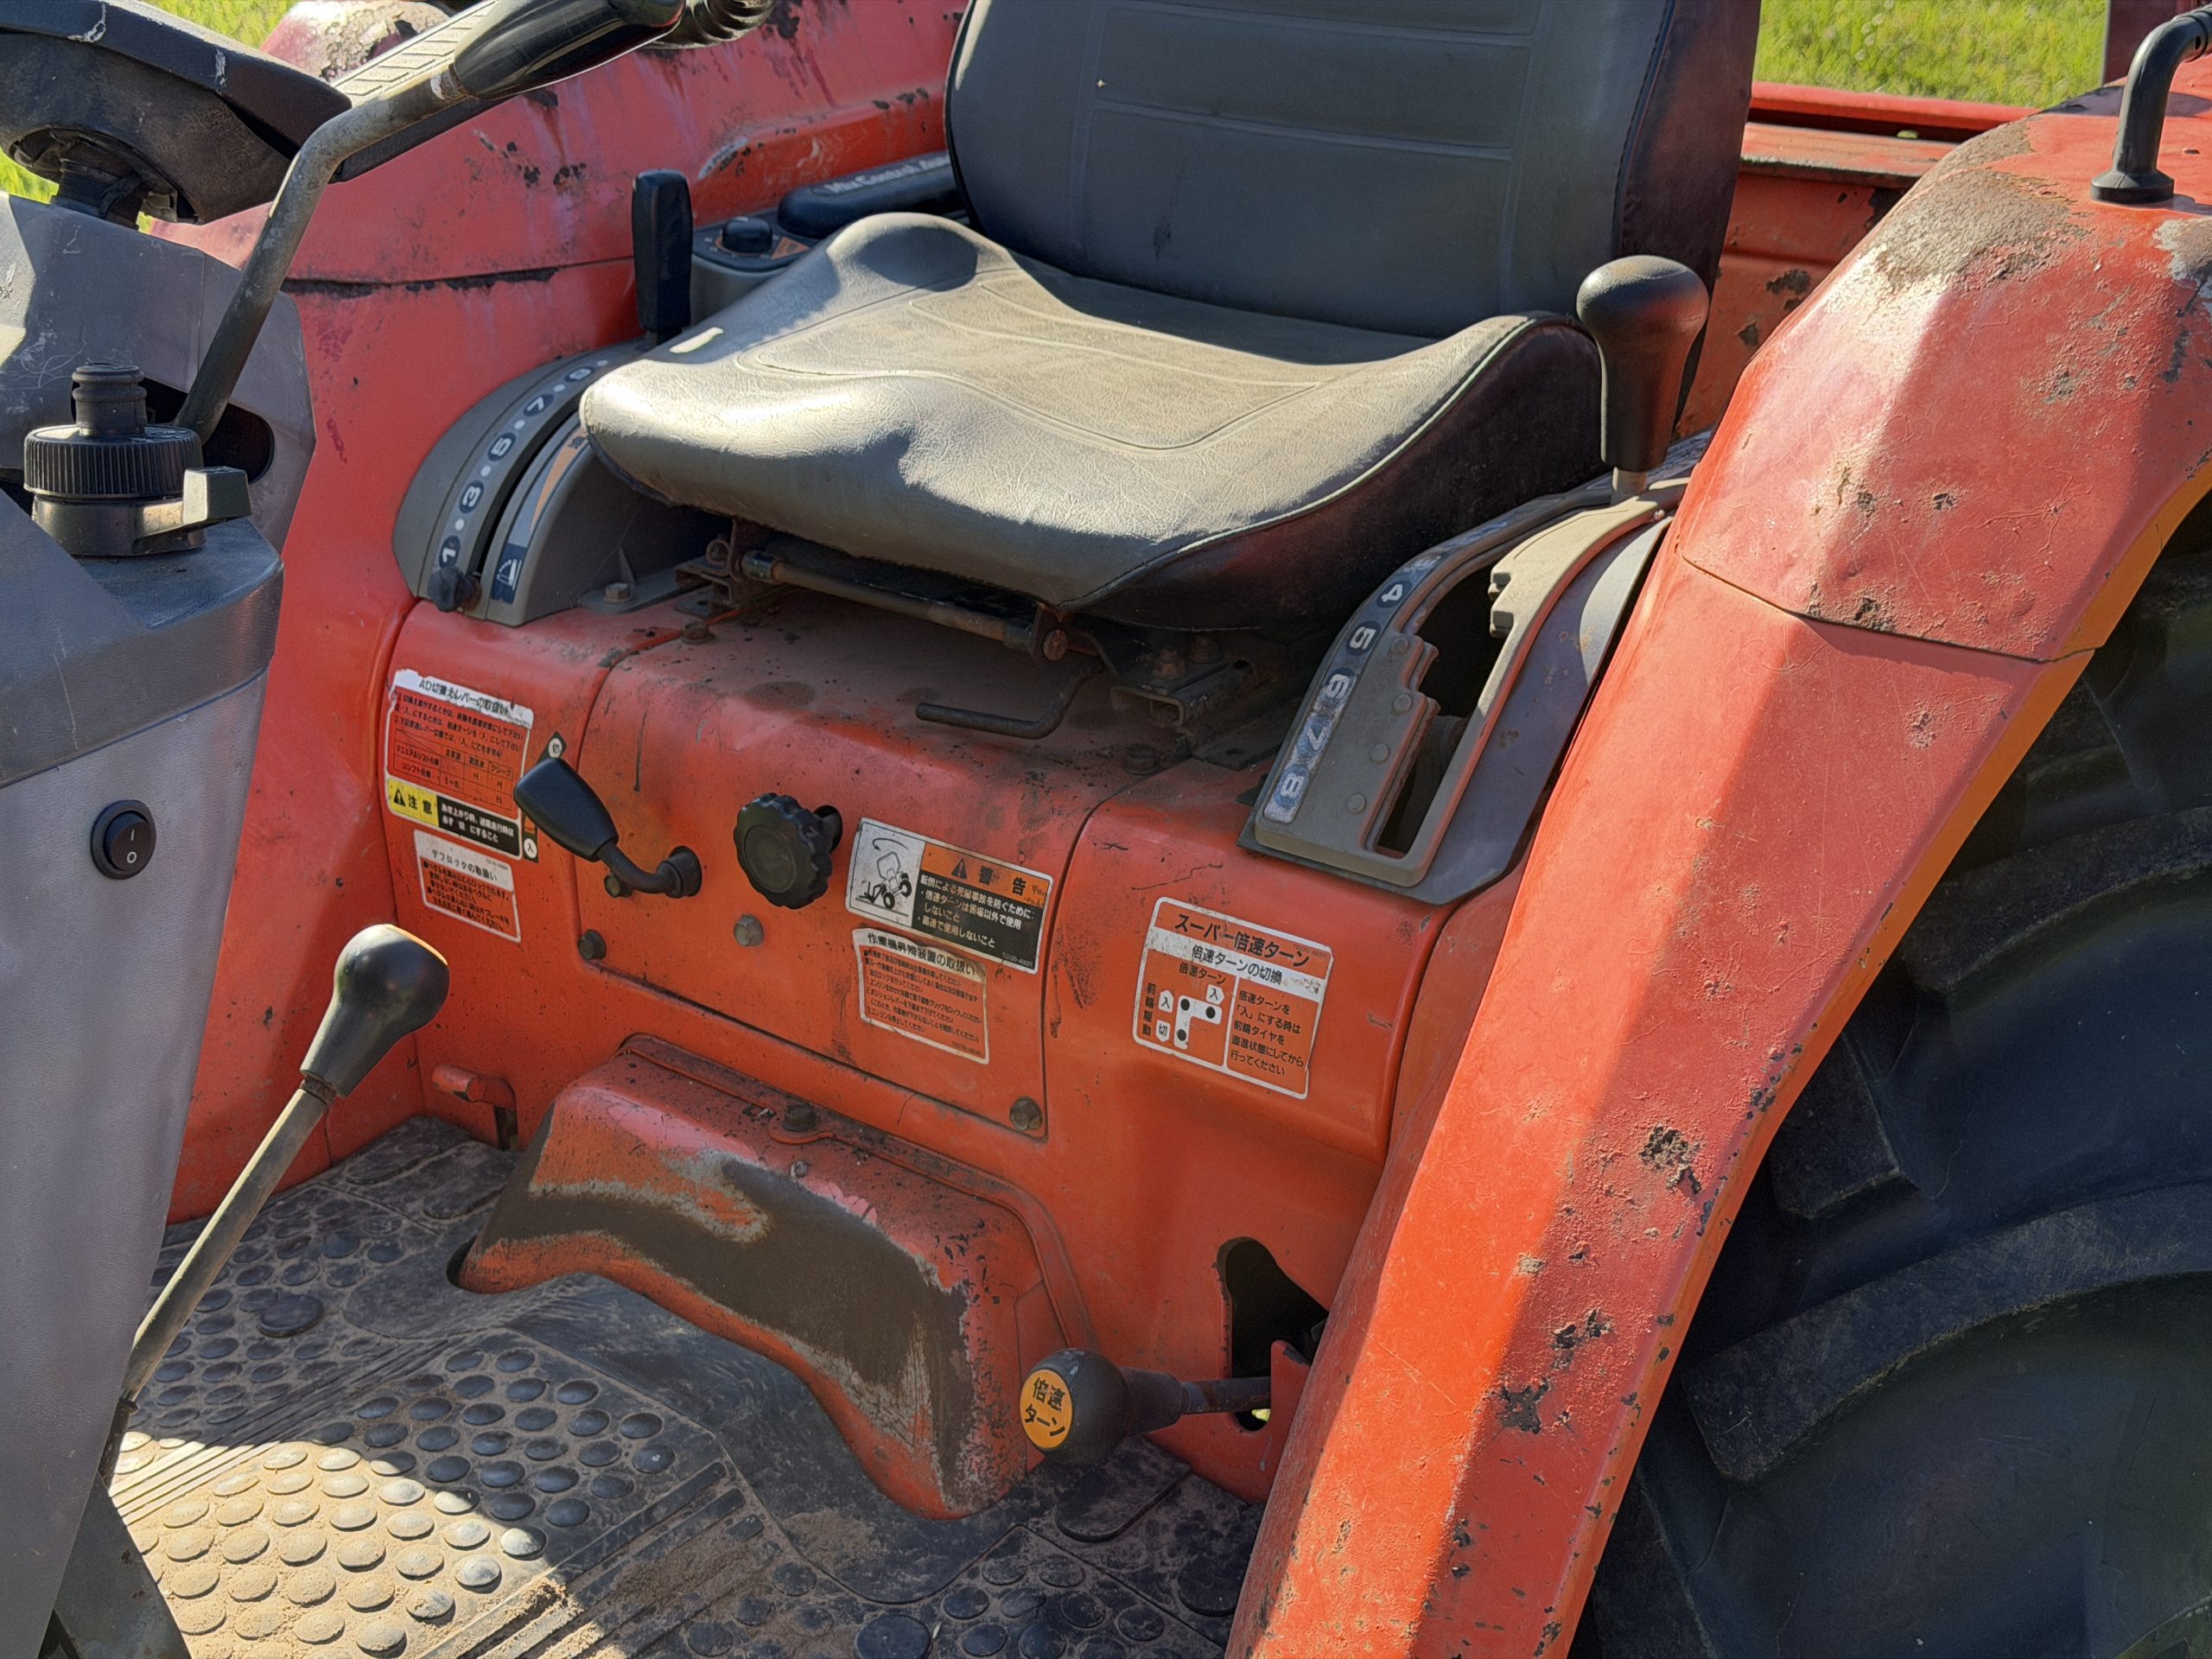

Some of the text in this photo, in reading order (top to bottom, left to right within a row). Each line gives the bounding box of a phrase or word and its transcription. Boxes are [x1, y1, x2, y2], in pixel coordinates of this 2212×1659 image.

[527, 397, 544, 412] 7
[491, 437, 512, 456] 5
[462, 486, 481, 508] 3
[442, 547, 456, 563] 1
[1381, 583, 1403, 602] 4
[1349, 626, 1376, 650] 5
[1325, 673, 1350, 698] 6
[1306, 726, 1328, 750] 7
[1281, 773, 1303, 798] 8
[408, 793, 433, 816] 注意
[527, 842, 534, 854] 入
[979, 866, 1027, 896] 警告
[924, 903, 960, 924] しないこと
[1174, 914, 1309, 968] スーパー倍速ターン
[867, 932, 976, 976] 作業機昇降装置の取扱い
[1192, 944, 1283, 986] 倍速ターンの切換
[1179, 962, 1227, 985] 倍速ターン
[1161, 996, 1171, 1009] 入
[1209, 988, 1219, 1001] 入
[1239, 990, 1290, 1014] 倍速ターンを
[1158, 1023, 1168, 1037] 切
[1236, 1004, 1300, 1034] 「入」にする時は
[1234, 1020, 1285, 1046] 前輪タイヤを
[1230, 1050, 1285, 1076] 行ってください
[1231, 1036, 1304, 1067] 直進状態にしてから
[1033, 1377, 1065, 1413] 倍速
[1025, 1403, 1065, 1437] ターン
